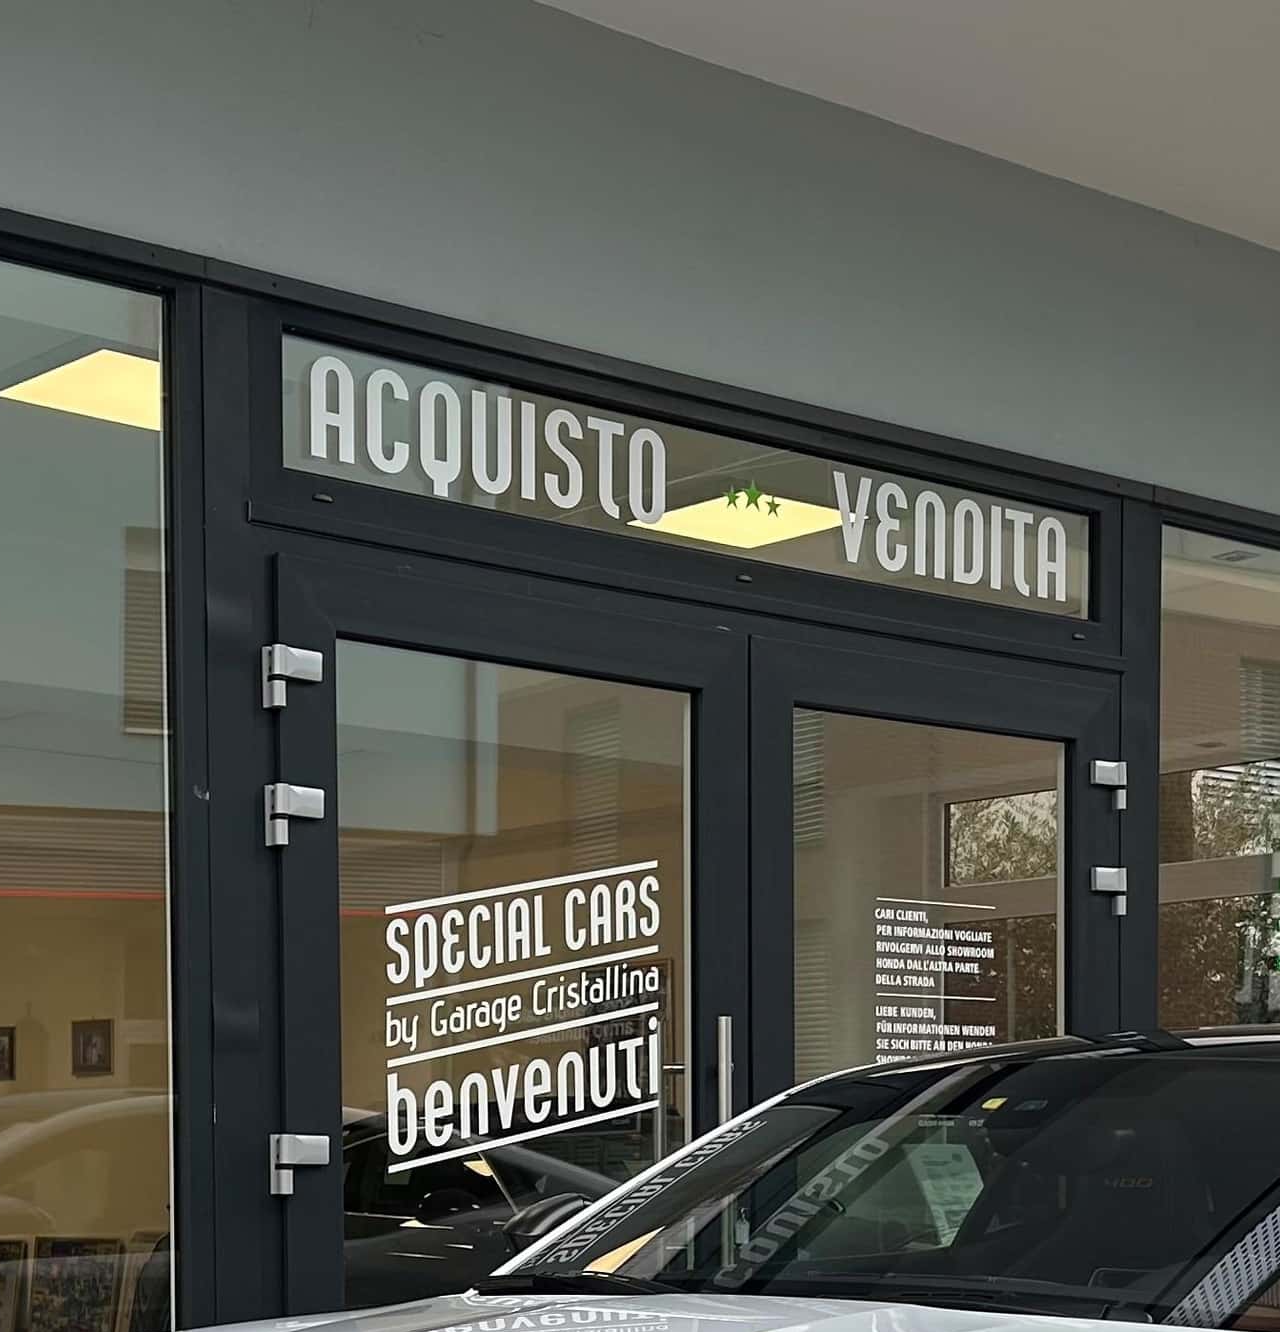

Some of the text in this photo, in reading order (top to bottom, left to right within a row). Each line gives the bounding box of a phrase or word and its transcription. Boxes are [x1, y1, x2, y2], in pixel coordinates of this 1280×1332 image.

[310, 356, 667, 525] ACQUISTO
[833, 471, 1067, 603] VENDITA
[875, 908, 928, 923] CARI CLIENTI,
[386, 875, 661, 988] SPECIAL CARS
[876, 925, 993, 943] PER INFORMAZIONI VOGLIATE
[876, 941, 995, 959] RIVOLGERVI ALLO SHOWROOM
[876, 958, 905, 970] HONDA
[955, 962, 980, 974] PARTE
[876, 974, 935, 988] DELLA STRADA
[386, 1011, 419, 1052] by
[431, 995, 522, 1034] Garage
[533, 963, 660, 1017] Cristallina
[875, 1006, 936, 1020] LIEBE KUNDEN,
[876, 1020, 996, 1037] FÜR INFORMATIONEN WENDEN
[876, 1039, 889, 1050] SIE
[891, 1039, 909, 1050] SICH
[911, 1040, 932, 1051] BITTE
[387, 1017, 660, 1156] benvenuti
